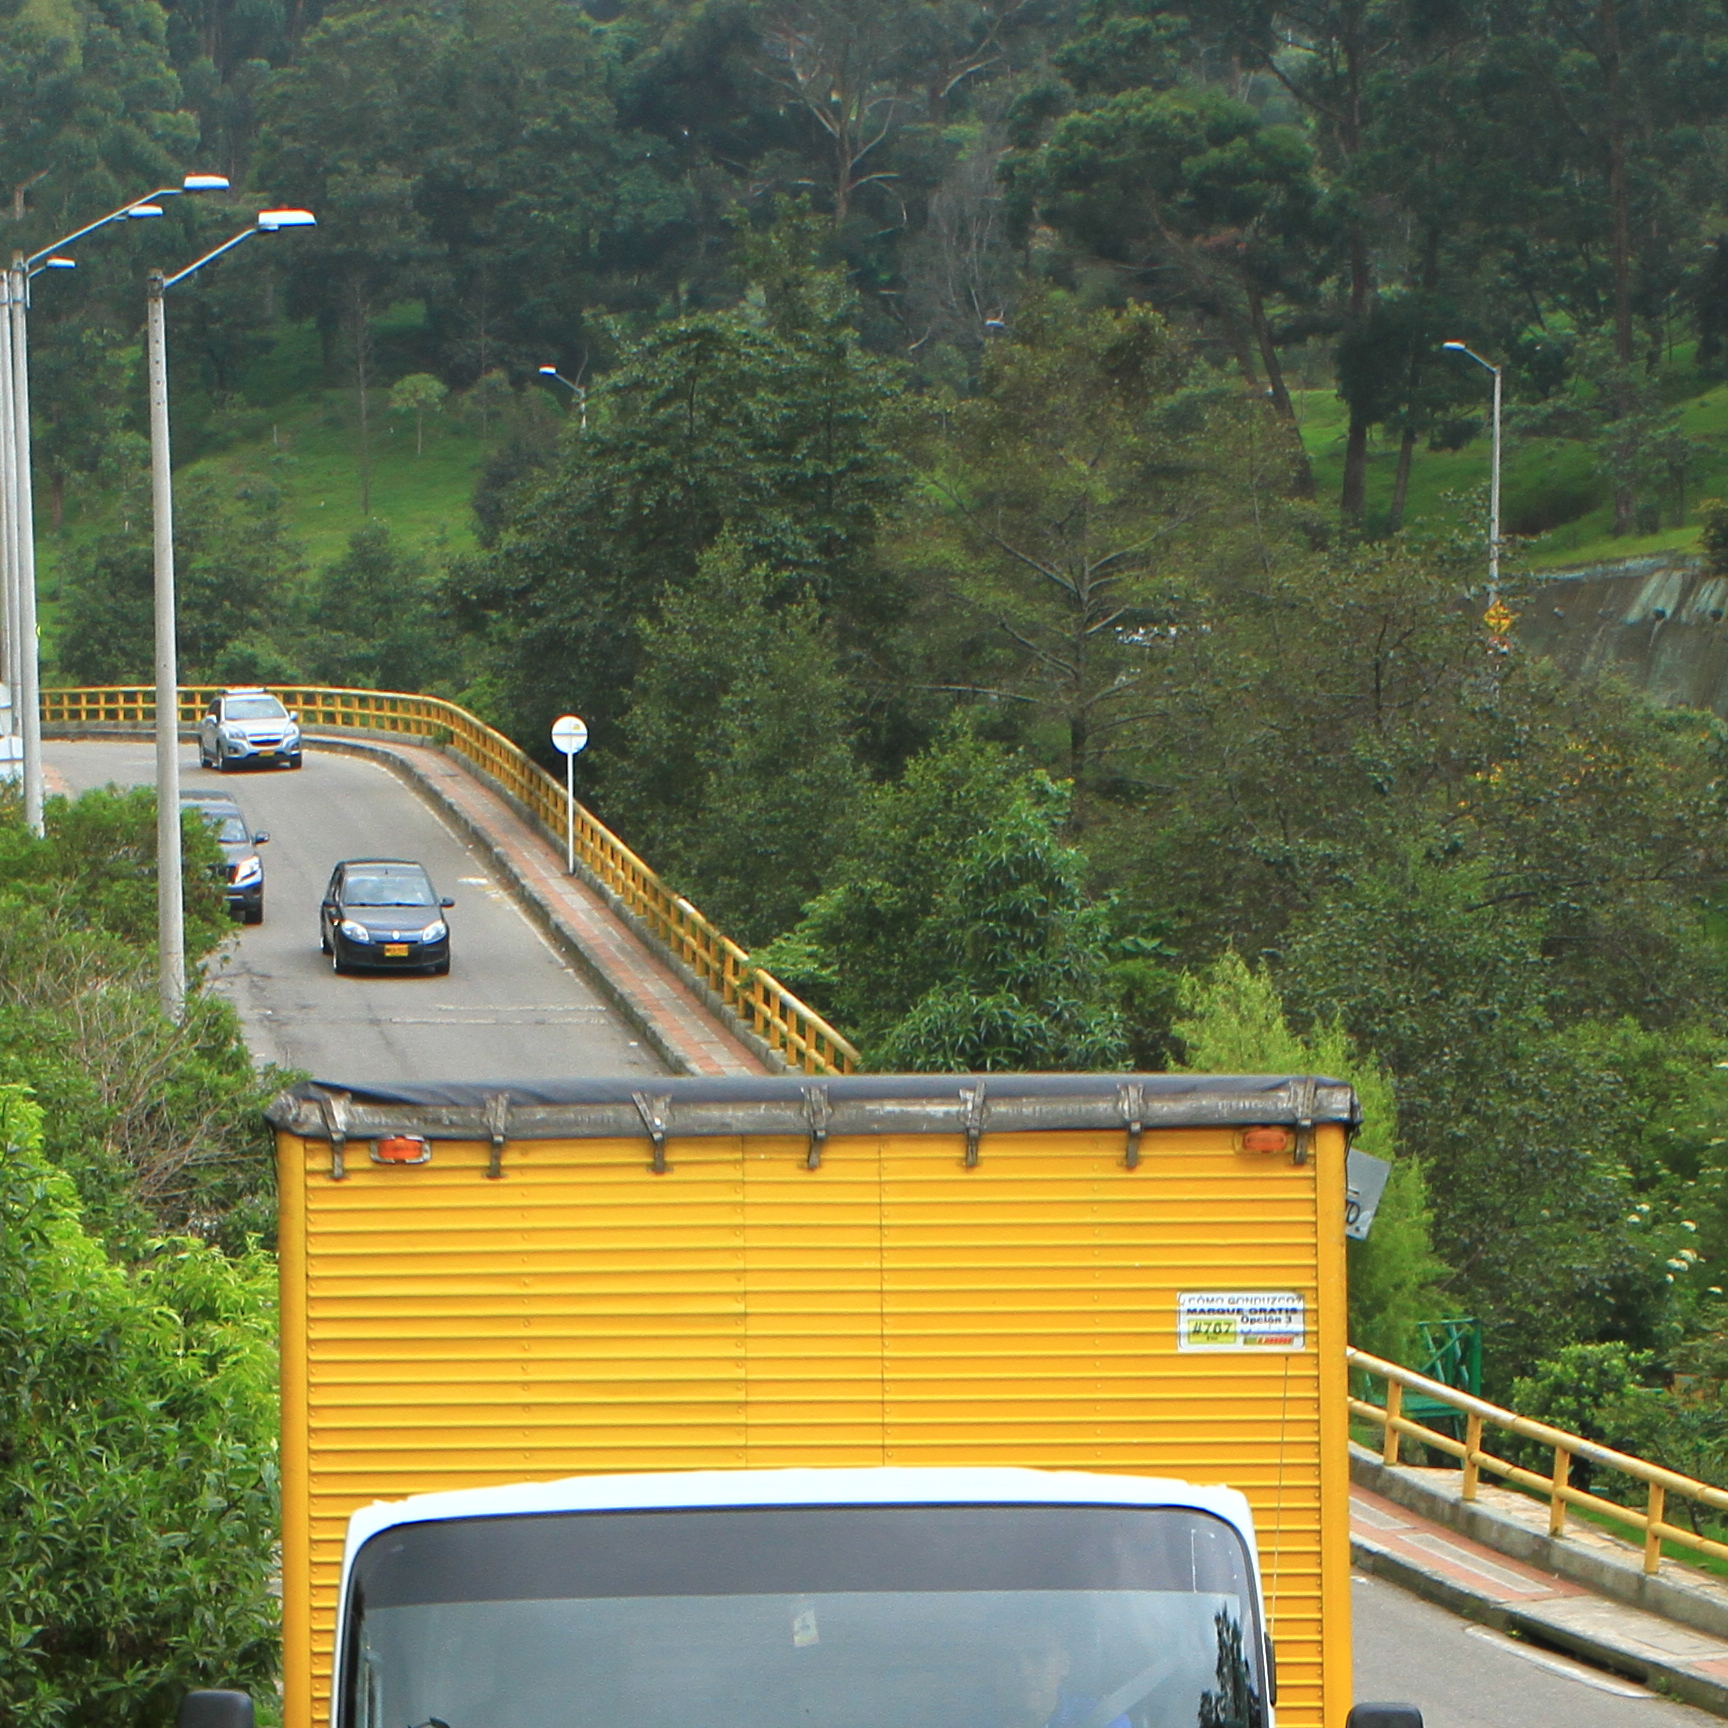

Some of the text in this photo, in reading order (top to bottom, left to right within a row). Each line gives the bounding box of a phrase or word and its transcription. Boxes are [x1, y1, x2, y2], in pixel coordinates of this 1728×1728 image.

[1186, 1307, 1299, 1316] MARQUE GRATIS
[1240, 1315, 1282, 1325] Opción
